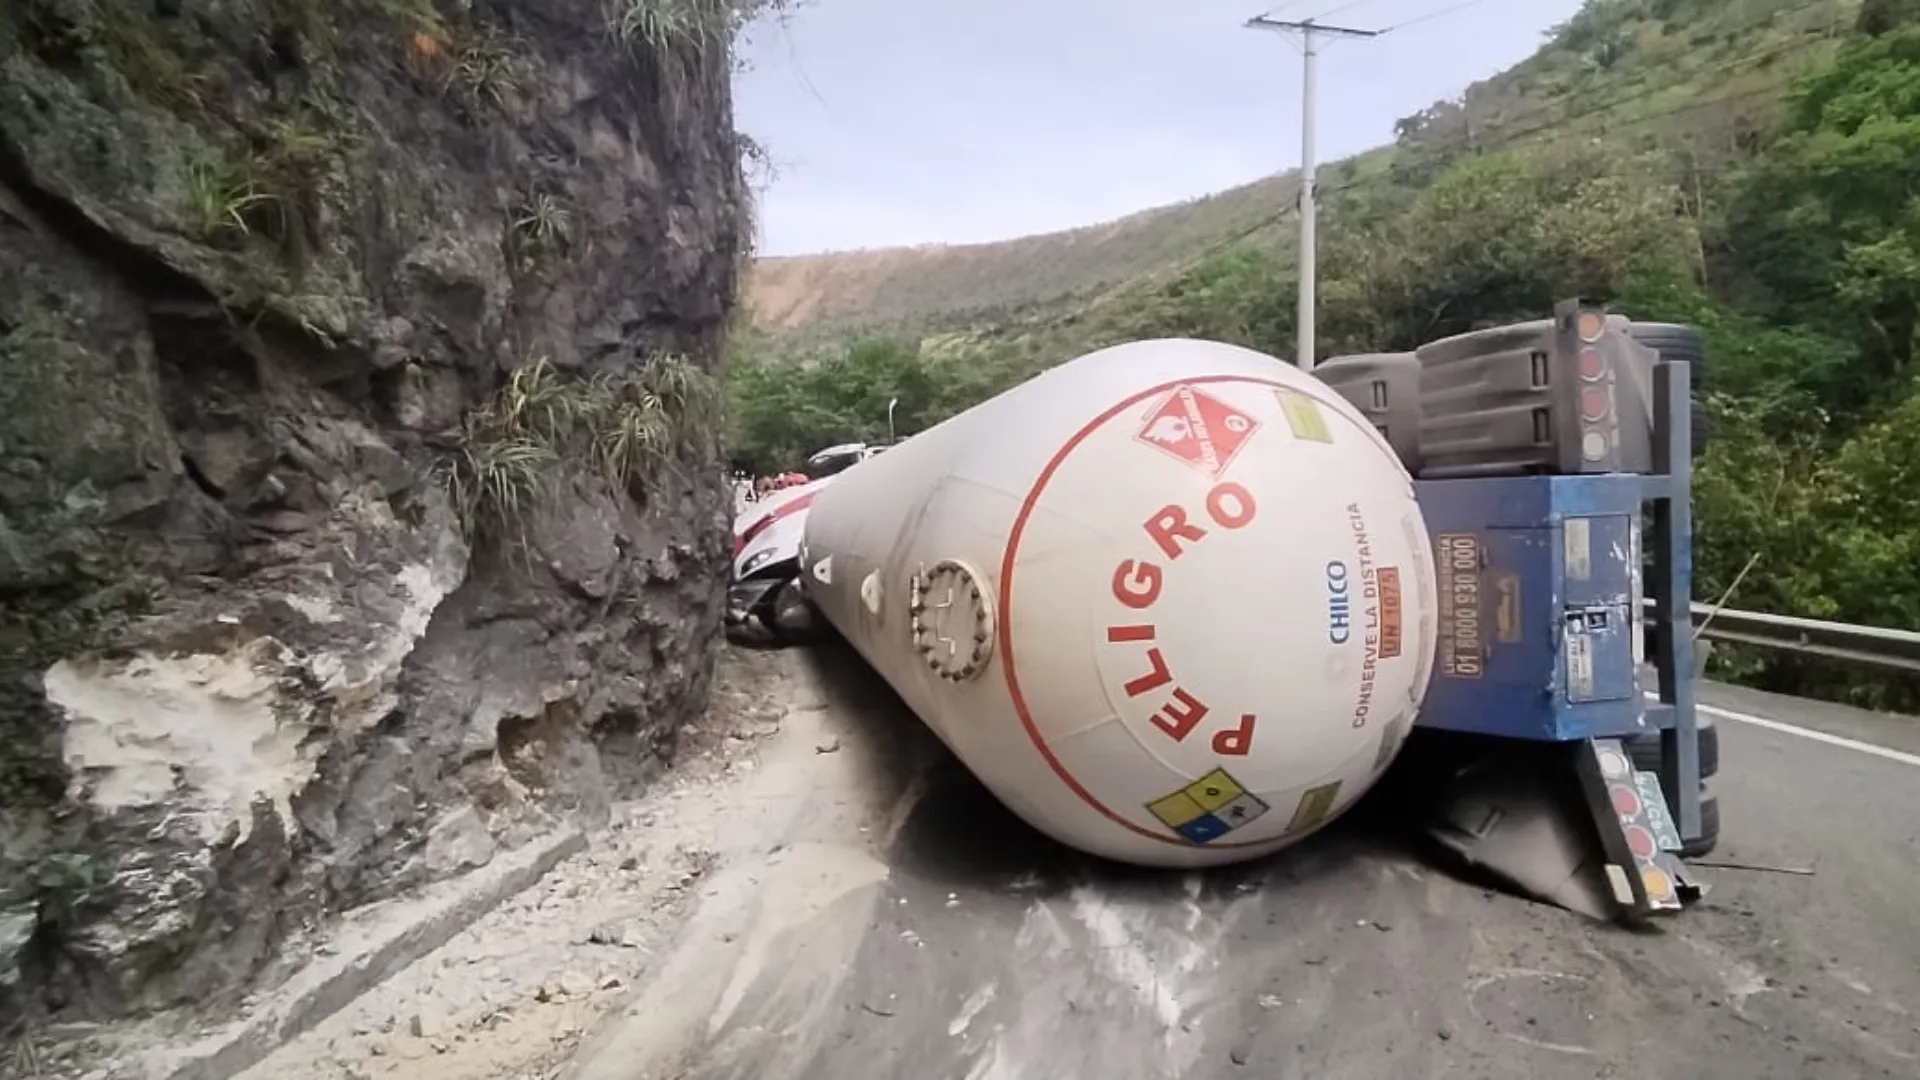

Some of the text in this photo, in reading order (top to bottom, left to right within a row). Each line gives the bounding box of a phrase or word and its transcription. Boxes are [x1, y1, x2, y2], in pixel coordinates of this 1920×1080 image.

[1107, 481, 1256, 756] PELIGRO
[1326, 560, 1350, 644] CHILCO
[1347, 502, 1378, 729] CONSERVE LA DISTANCIA
[1381, 572, 1397, 653] UN 1075
[1452, 539, 1480, 674] 01 8000 930 000
